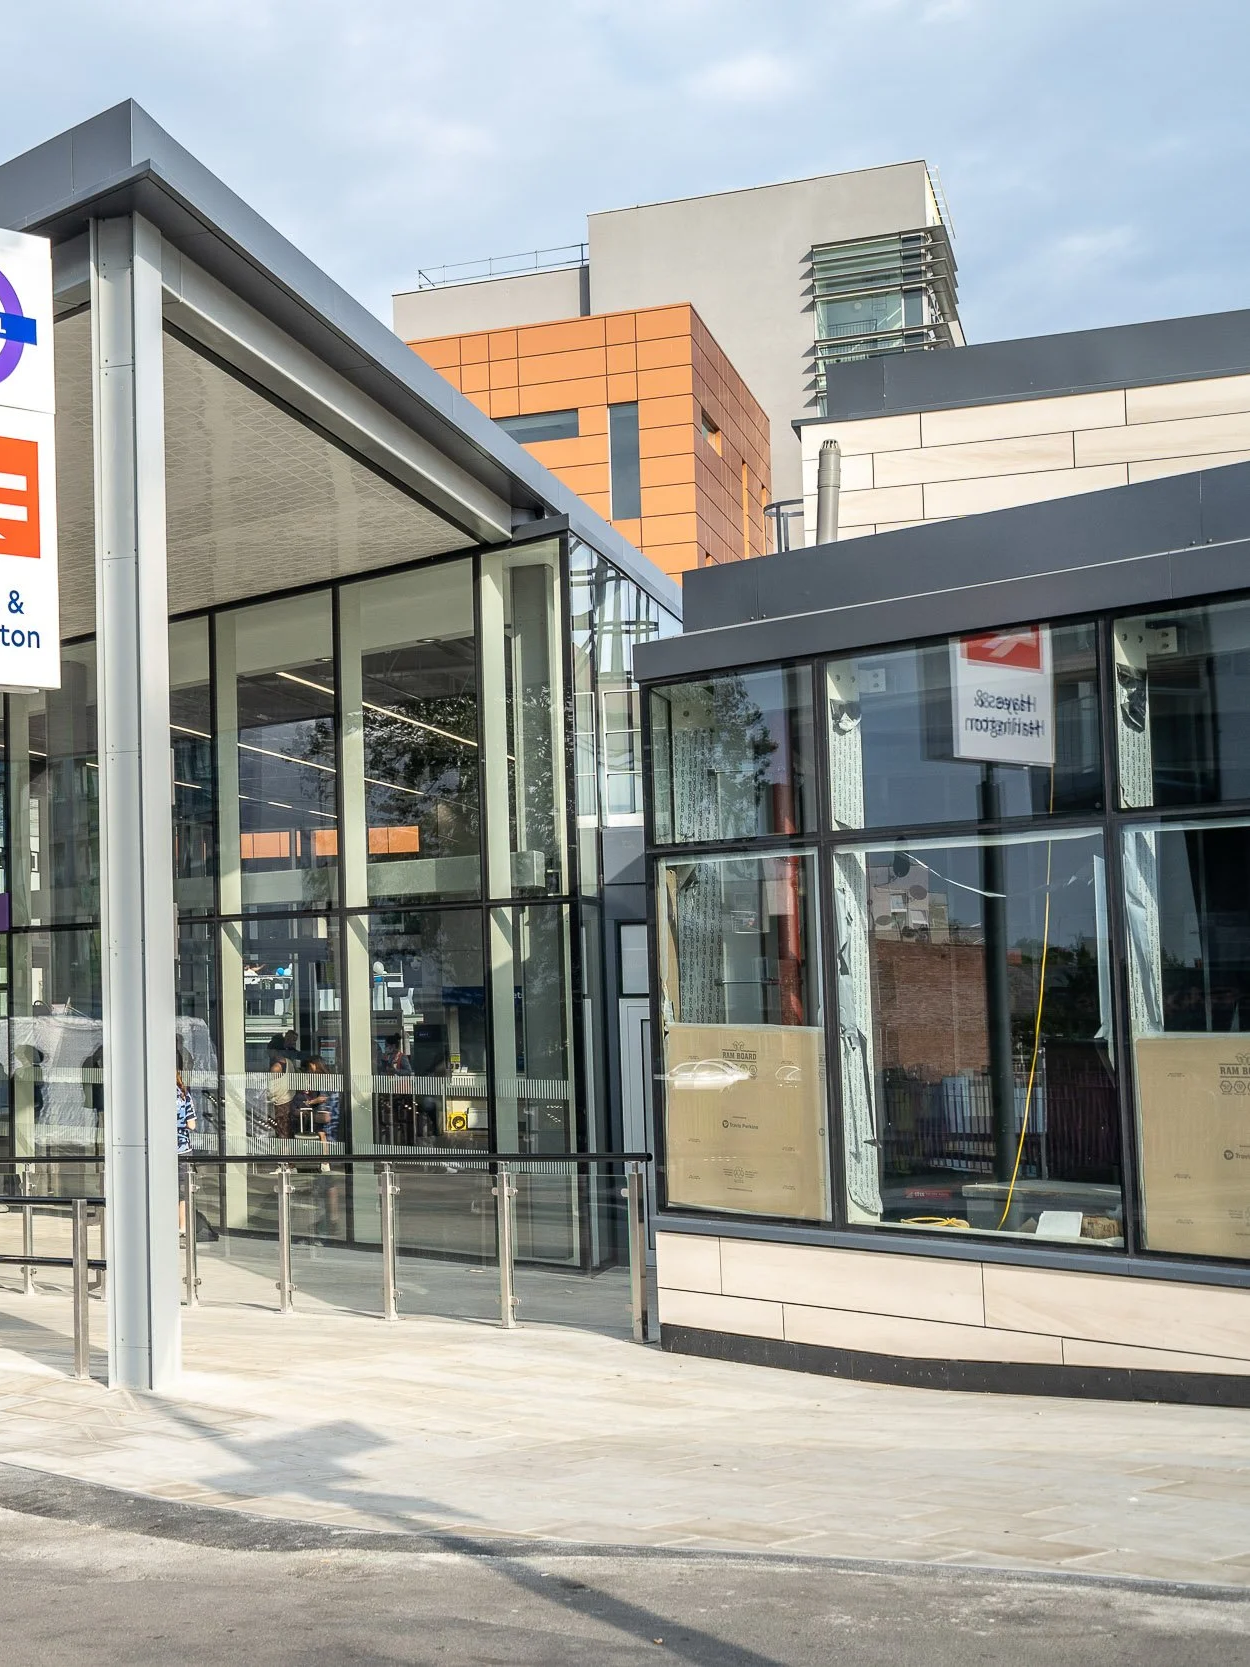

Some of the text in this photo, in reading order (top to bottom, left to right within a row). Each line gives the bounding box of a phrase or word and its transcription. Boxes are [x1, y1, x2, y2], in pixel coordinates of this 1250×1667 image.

[8, 590, 24, 614] &
[737, 1052, 757, 1060] BOARD
[1220, 1066, 1239, 1075] RAM
